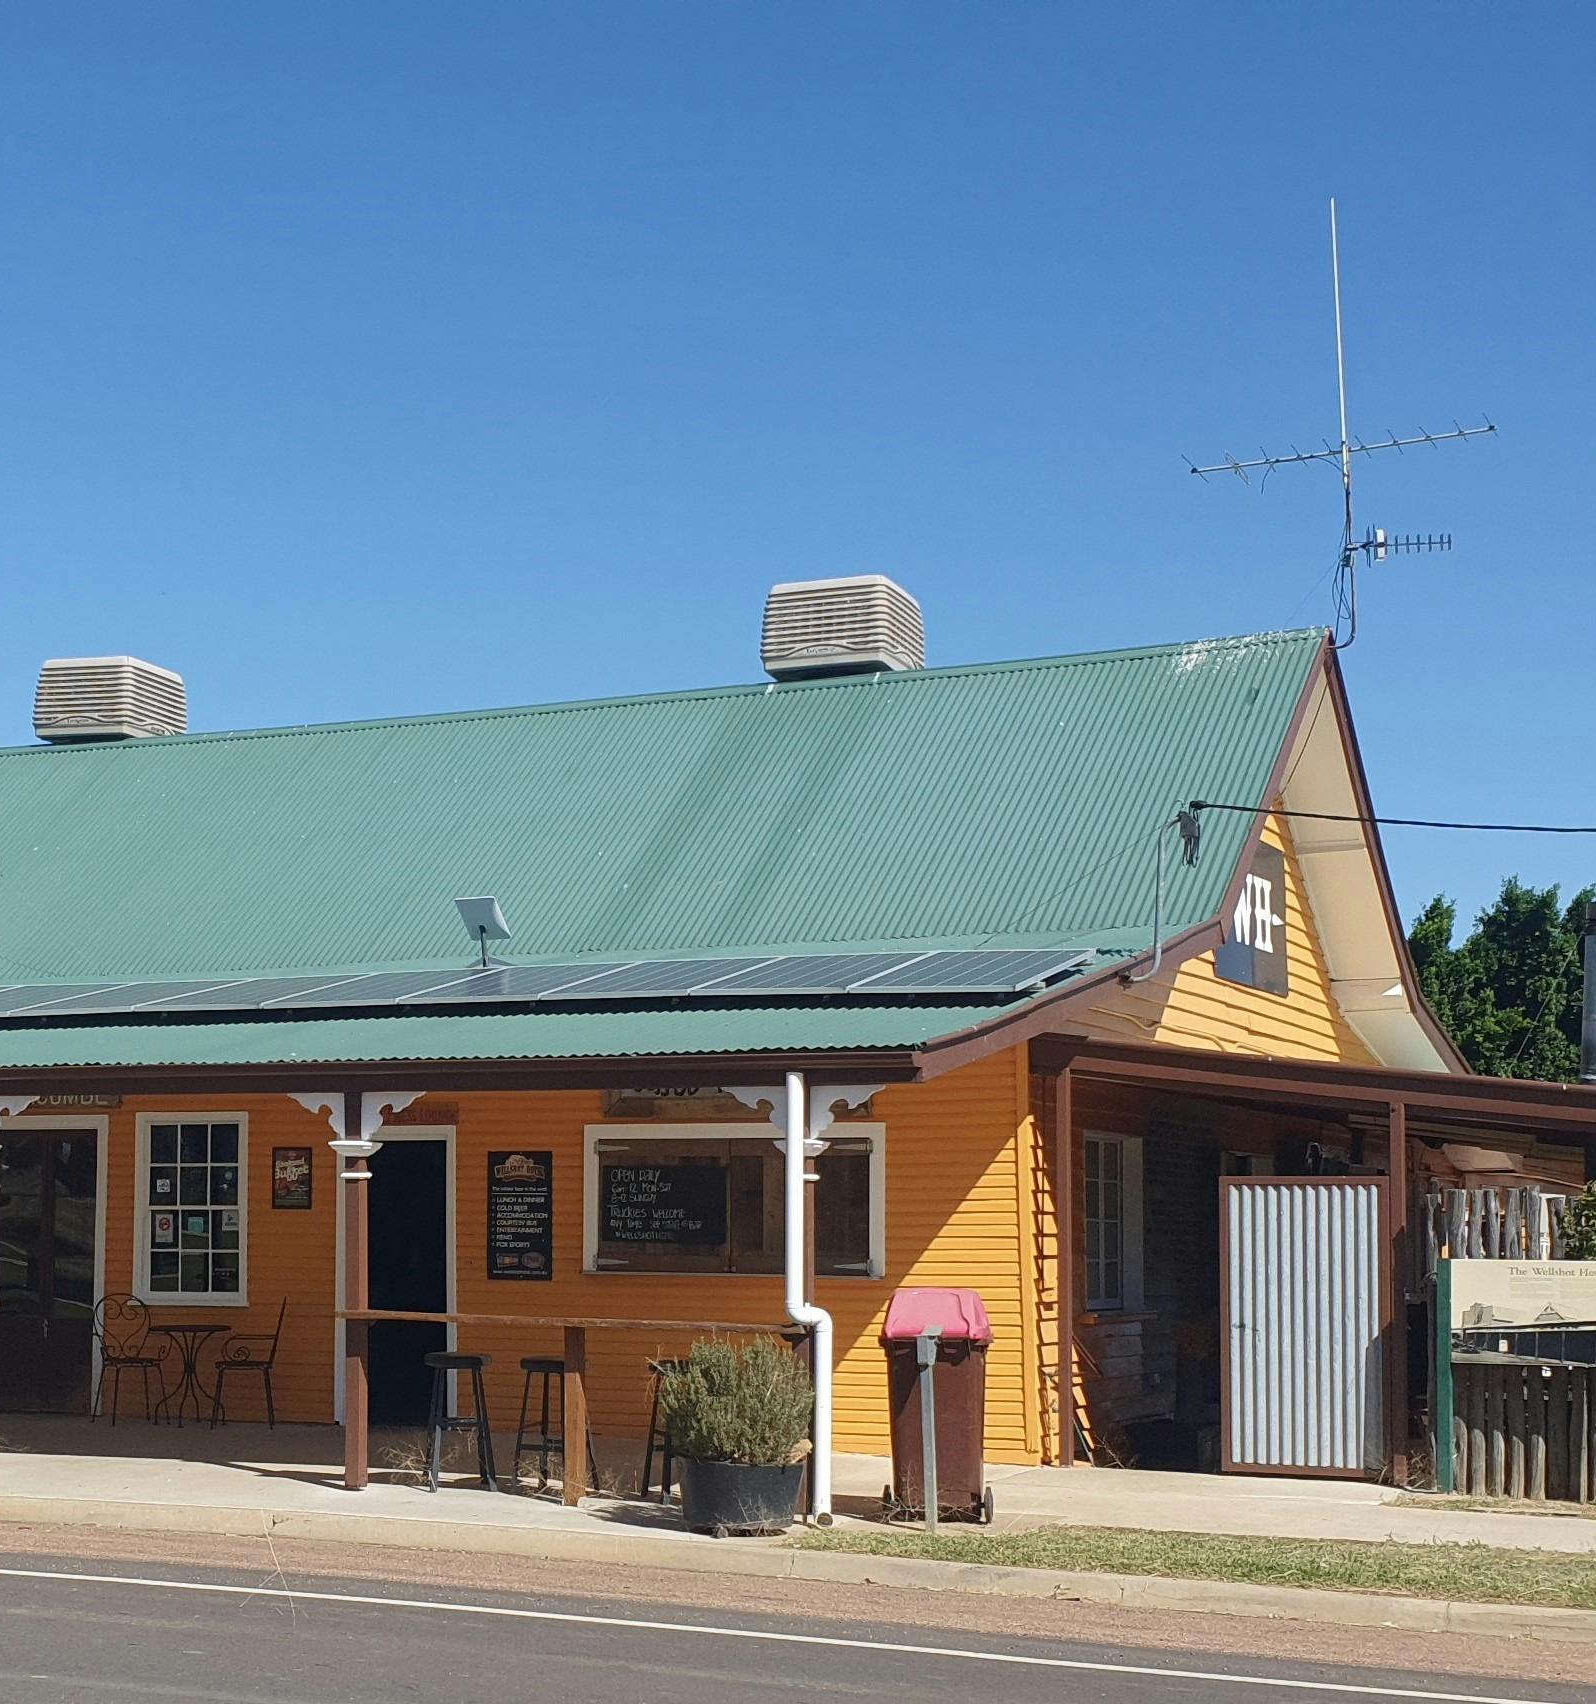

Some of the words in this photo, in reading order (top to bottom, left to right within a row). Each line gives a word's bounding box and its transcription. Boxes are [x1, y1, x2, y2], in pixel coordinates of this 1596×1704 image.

[610, 1168, 635, 1182] OPEN
[1507, 1266, 1528, 1276] The
[1532, 1266, 1575, 1276] Wellshot
